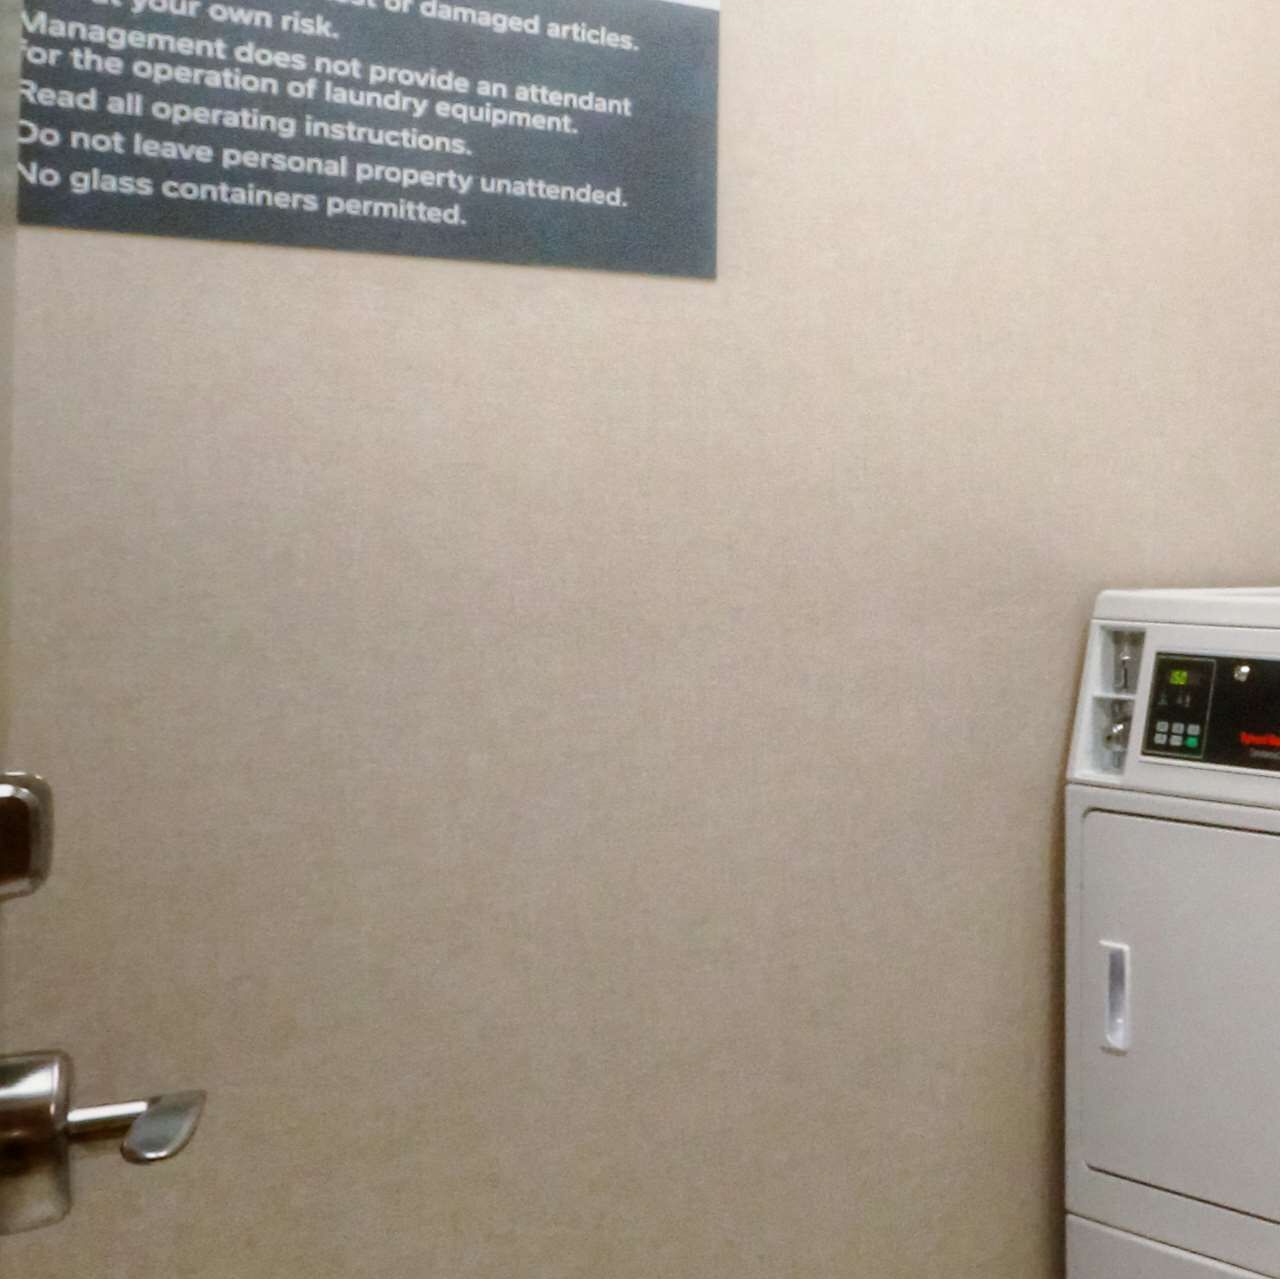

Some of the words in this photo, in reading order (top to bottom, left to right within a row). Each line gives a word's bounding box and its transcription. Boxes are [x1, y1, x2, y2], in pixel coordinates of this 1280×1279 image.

[208, 3, 272, 29] own
[281, 11, 339, 39] risk.
[546, 19, 640, 51] articles.
[69, 45, 124, 74] the
[132, 59, 279, 95] operation
[287, 76, 318, 100] of
[325, 81, 428, 117] laundry
[435, 99, 578, 134] equipment.
[234, 41, 306, 71] does
[314, 55, 362, 78] not
[369, 64, 469, 94] provide
[476, 79, 507, 99] an
[515, 83, 632, 116] attendant
[106, 92, 144, 117] all
[151, 101, 297, 139] operating
[304, 114, 472, 156] instructions.
[69, 167, 154, 197] glass
[161, 179, 319, 212] containers
[327, 195, 466, 225] permitted.
[70, 128, 125, 154] not
[133, 133, 214, 163] leave
[222, 145, 348, 177] personal
[356, 161, 473, 194] property
[480, 178, 628, 207] unattended.
